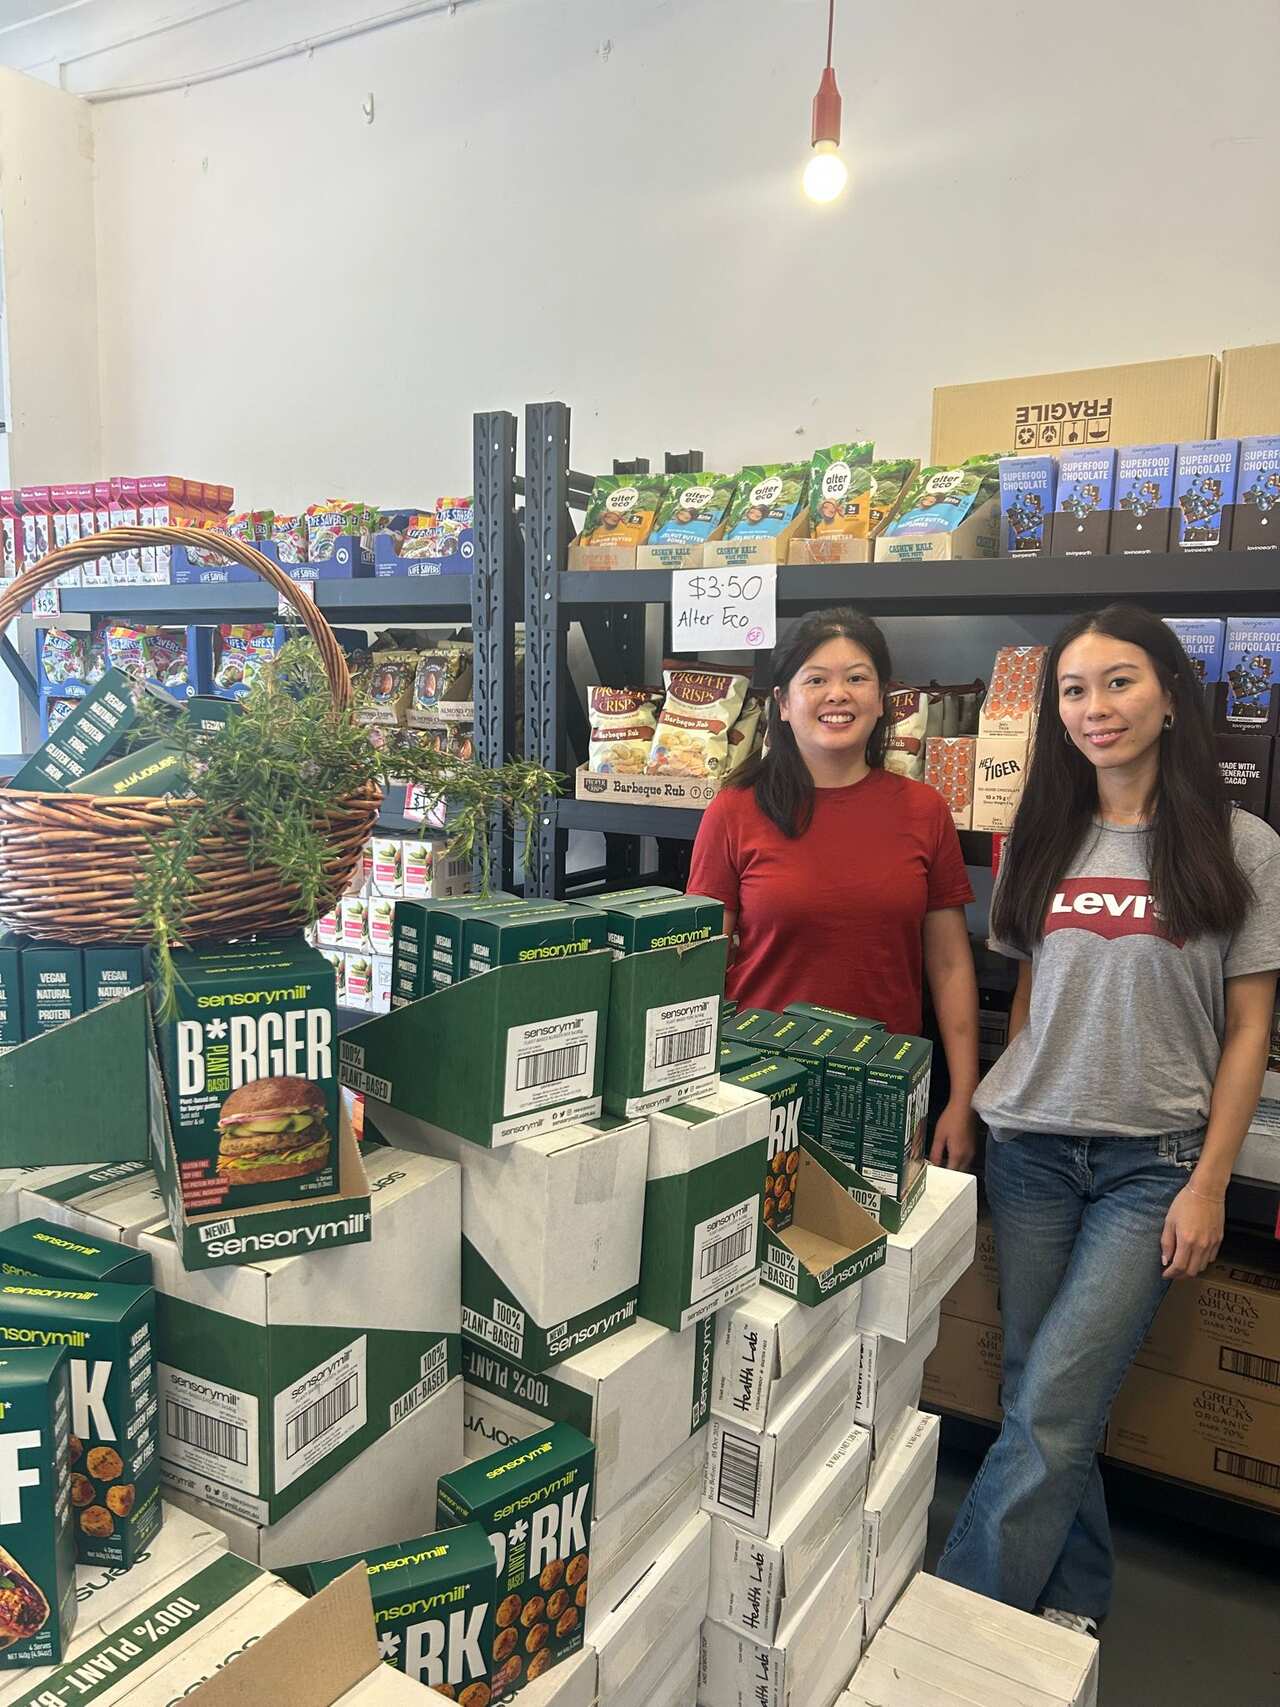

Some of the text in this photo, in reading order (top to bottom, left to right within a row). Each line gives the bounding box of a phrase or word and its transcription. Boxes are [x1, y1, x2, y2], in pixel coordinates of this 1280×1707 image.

[1016, 398, 1112, 424] FRAGILE
[1062, 461, 1109, 472] SUPERFOOD
[1120, 457, 1169, 469] SUPERFOOD
[1180, 453, 1231, 466] SUPERFOOD
[1003, 471, 1047, 482] SUPERFOOD
[1062, 471, 1108, 481] CHOCOLATE
[1120, 468, 1169, 479] CHOCOLATE
[1179, 463, 1231, 476] CHOCOLATE
[1003, 480, 1048, 490] CHOCOLATE
[408, 565, 420, 576] LIFE
[420, 564, 441, 576] SAVERS
[677, 606, 749, 628] Alter Eco
[1230, 631, 1280, 642] SUPERFOOD
[1228, 641, 1280, 652] CHOCOLATE
[671, 672, 727, 690] PROPER
[674, 687, 715, 703] CRISPS
[599, 699, 637, 712] CRISPS
[664, 714, 709, 729] Barbeque Rub
[628, 729, 640, 738] Rub
[67, 760, 86, 778] FREE
[979, 757, 995, 769] HEY
[985, 759, 1020, 782] TIGER
[1238, 763, 1256, 771] WITH
[613, 781, 686, 798] Barbeque Rub
[1224, 777, 1247, 786] CACAO
[435, 934, 452, 948] VEGAN
[607, 932, 624, 945] VEGAN
[651, 926, 712, 949] sensorymill
[473, 943, 490, 957] VEGAN
[520, 938, 591, 962] sensorymill
[40, 973, 66, 983] VEGAN
[101, 971, 128, 981] VEGAN
[36, 989, 72, 1000] NATURAL
[197, 984, 309, 1008] sensorymill
[38, 1009, 71, 1020] PROTEIN
[661, 1002, 709, 1020] sensorymill
[524, 1018, 584, 1040] sensorymill
[206, 1045, 230, 1080] PLANT
[342, 1043, 361, 1065] 100%
[341, 1065, 389, 1099] PLANT-BASED
[738, 1064, 778, 1083] sensorymill
[207, 1077, 230, 1092] BASED
[501, 1118, 545, 1137] sensorymill
[851, 1190, 877, 1208] 100%
[706, 1204, 750, 1233] sensorymill
[203, 1220, 231, 1240] NEW!
[207, 1212, 366, 1259] sensorymill
[33, 1233, 100, 1256] sensorymill
[771, 1248, 795, 1271] 100%
[821, 1244, 884, 1293] sensorymill
[3, 1286, 98, 1300] sensorymill
[1206, 1287, 1251, 1306] GREEN
[496, 1303, 521, 1331] 100%
[1199, 1308, 1255, 1329] ORGANIC
[462, 1309, 521, 1354] PLANT-BASED
[550, 1300, 636, 1357] sensorymill
[423, 1343, 445, 1373] 100%
[291, 1349, 351, 1399] sensorymill
[170, 1373, 237, 1405] sensorymill
[394, 1367, 446, 1420] PLANT-BASED
[513, 1374, 549, 1407] 100%
[733, 1367, 754, 1412] Health
[135, 1389, 150, 1413] FIBRE
[1201, 1390, 1246, 1409] GREEN
[127, 1399, 158, 1440] GLUTEN FREE
[1194, 1410, 1249, 1431] ORGANIC
[132, 1440, 155, 1473] SOY FREE
[486, 1441, 553, 1479] sensorymill
[493, 1468, 578, 1521] sensorymill
[508, 1541, 525, 1577] PLANT
[507, 1569, 525, 1591] BASED
[742, 1587, 761, 1629] Health
[133, 1597, 201, 1642] 100%
